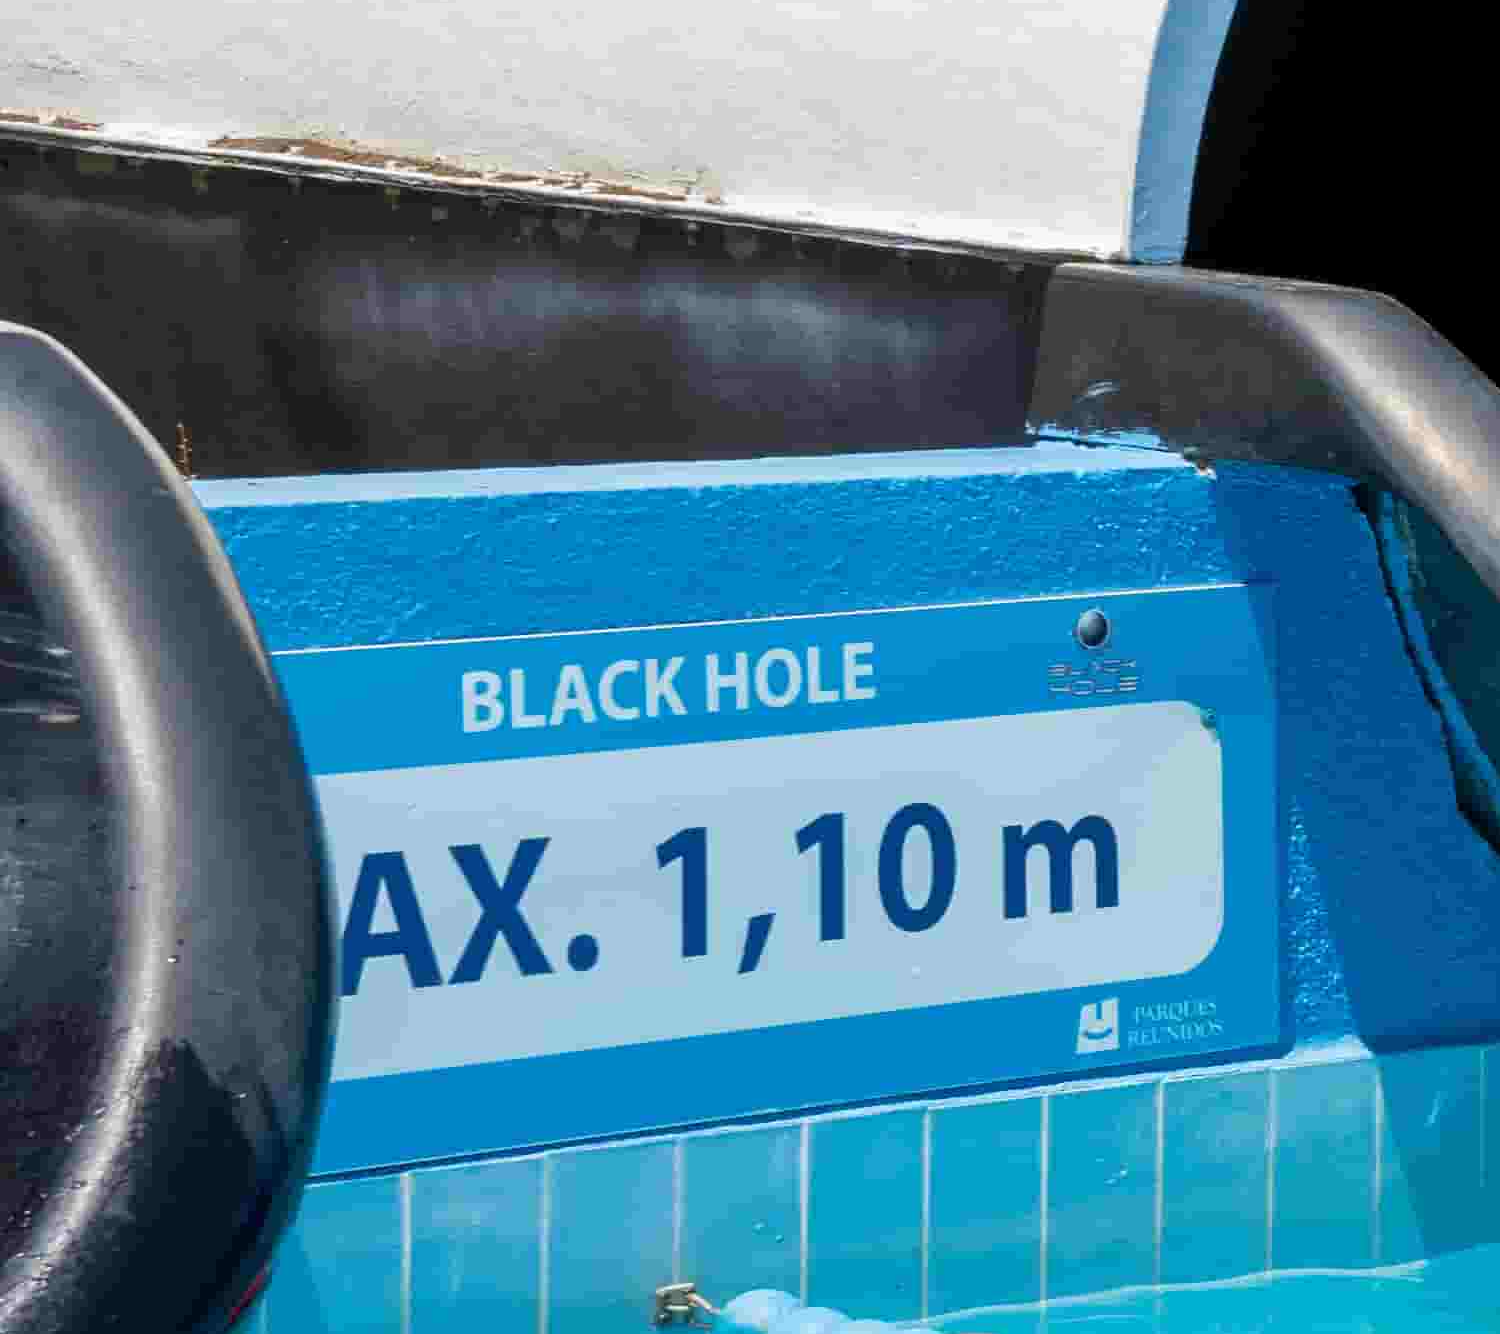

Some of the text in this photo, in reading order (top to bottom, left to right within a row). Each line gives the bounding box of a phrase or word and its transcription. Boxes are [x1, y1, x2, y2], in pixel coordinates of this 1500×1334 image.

[461, 641, 878, 734] BLACK HOLE
[335, 801, 1120, 998] AX. 1,10 m
[1128, 1018, 1225, 1045] REUNIDOS
[1134, 1000, 1217, 1024] PARQUES
